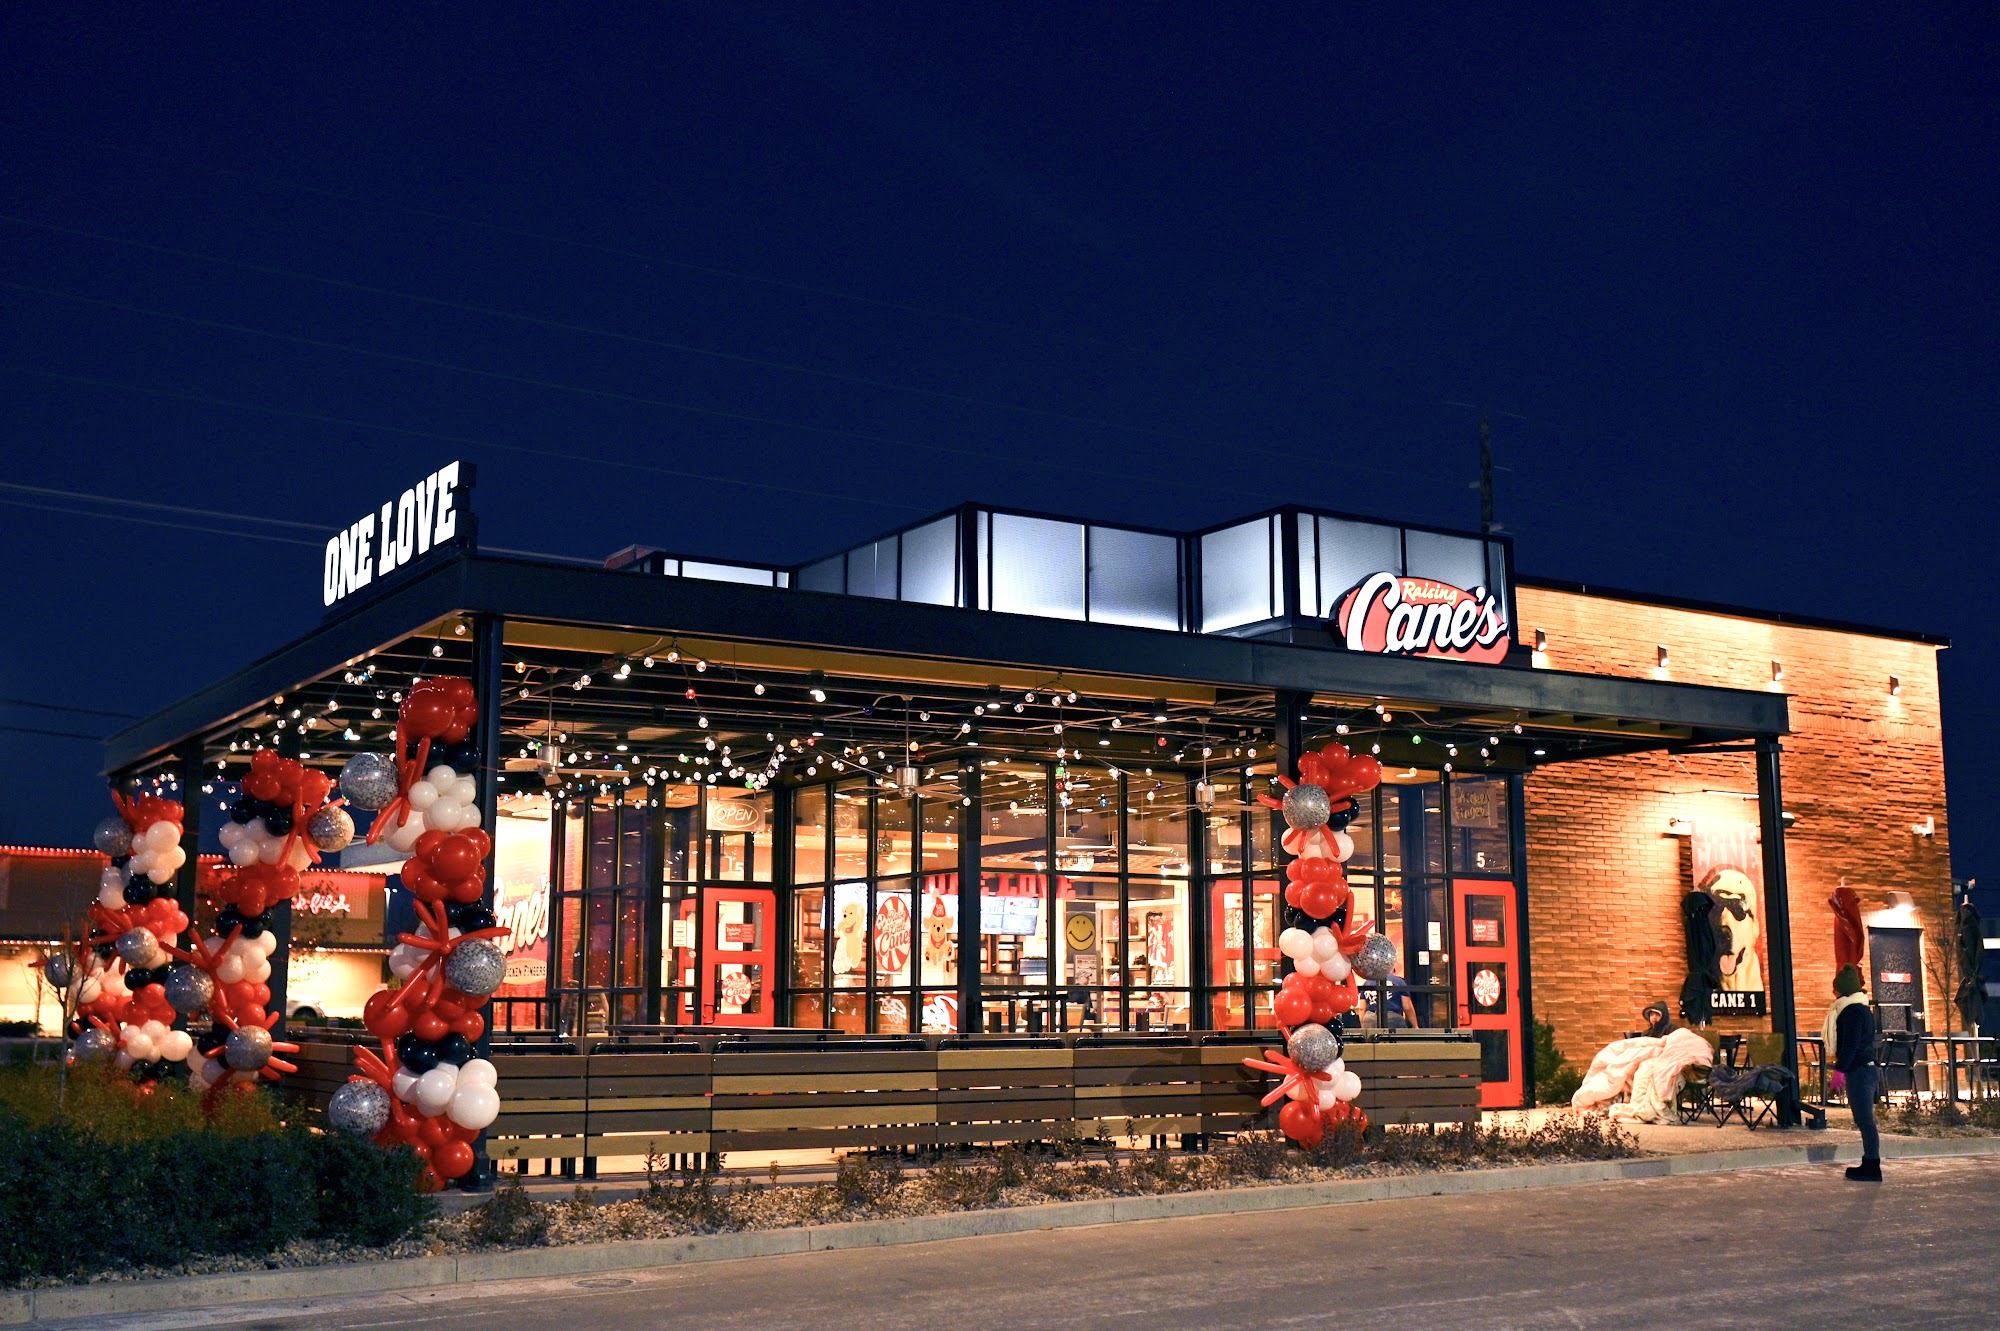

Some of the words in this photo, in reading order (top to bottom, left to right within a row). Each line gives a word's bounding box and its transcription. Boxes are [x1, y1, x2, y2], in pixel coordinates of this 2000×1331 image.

[323, 512, 375, 607] ONE
[378, 460, 460, 577] LOVE
[1402, 580, 1458, 606] Raising
[1346, 571, 1508, 653] Cane's
[716, 808, 754, 821] OPEN
[1476, 851, 1486, 868] 5
[879, 931, 909, 956] Cane
[1711, 993, 1745, 1008] CANE
[1750, 993, 1757, 1008] 1
